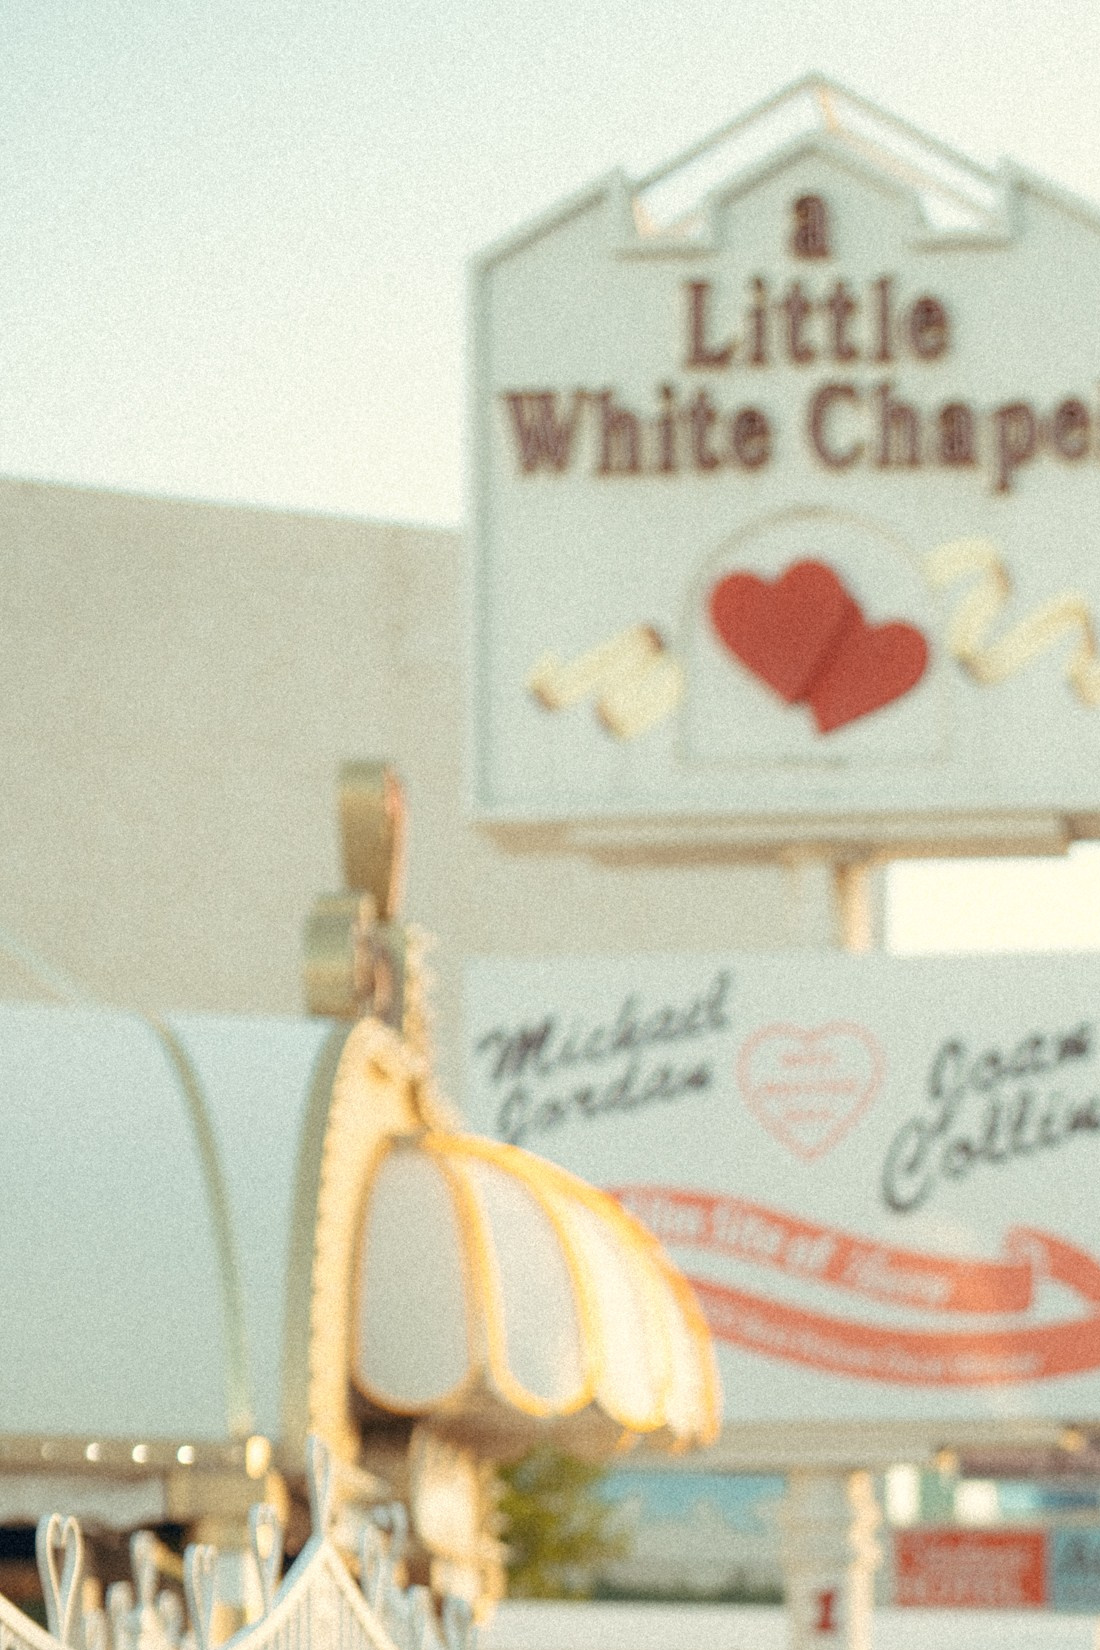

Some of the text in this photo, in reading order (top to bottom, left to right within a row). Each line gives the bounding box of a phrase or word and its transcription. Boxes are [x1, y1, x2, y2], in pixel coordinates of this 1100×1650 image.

[793, 194, 830, 260] a
[685, 277, 950, 368] Little
[504, 384, 772, 476] White
